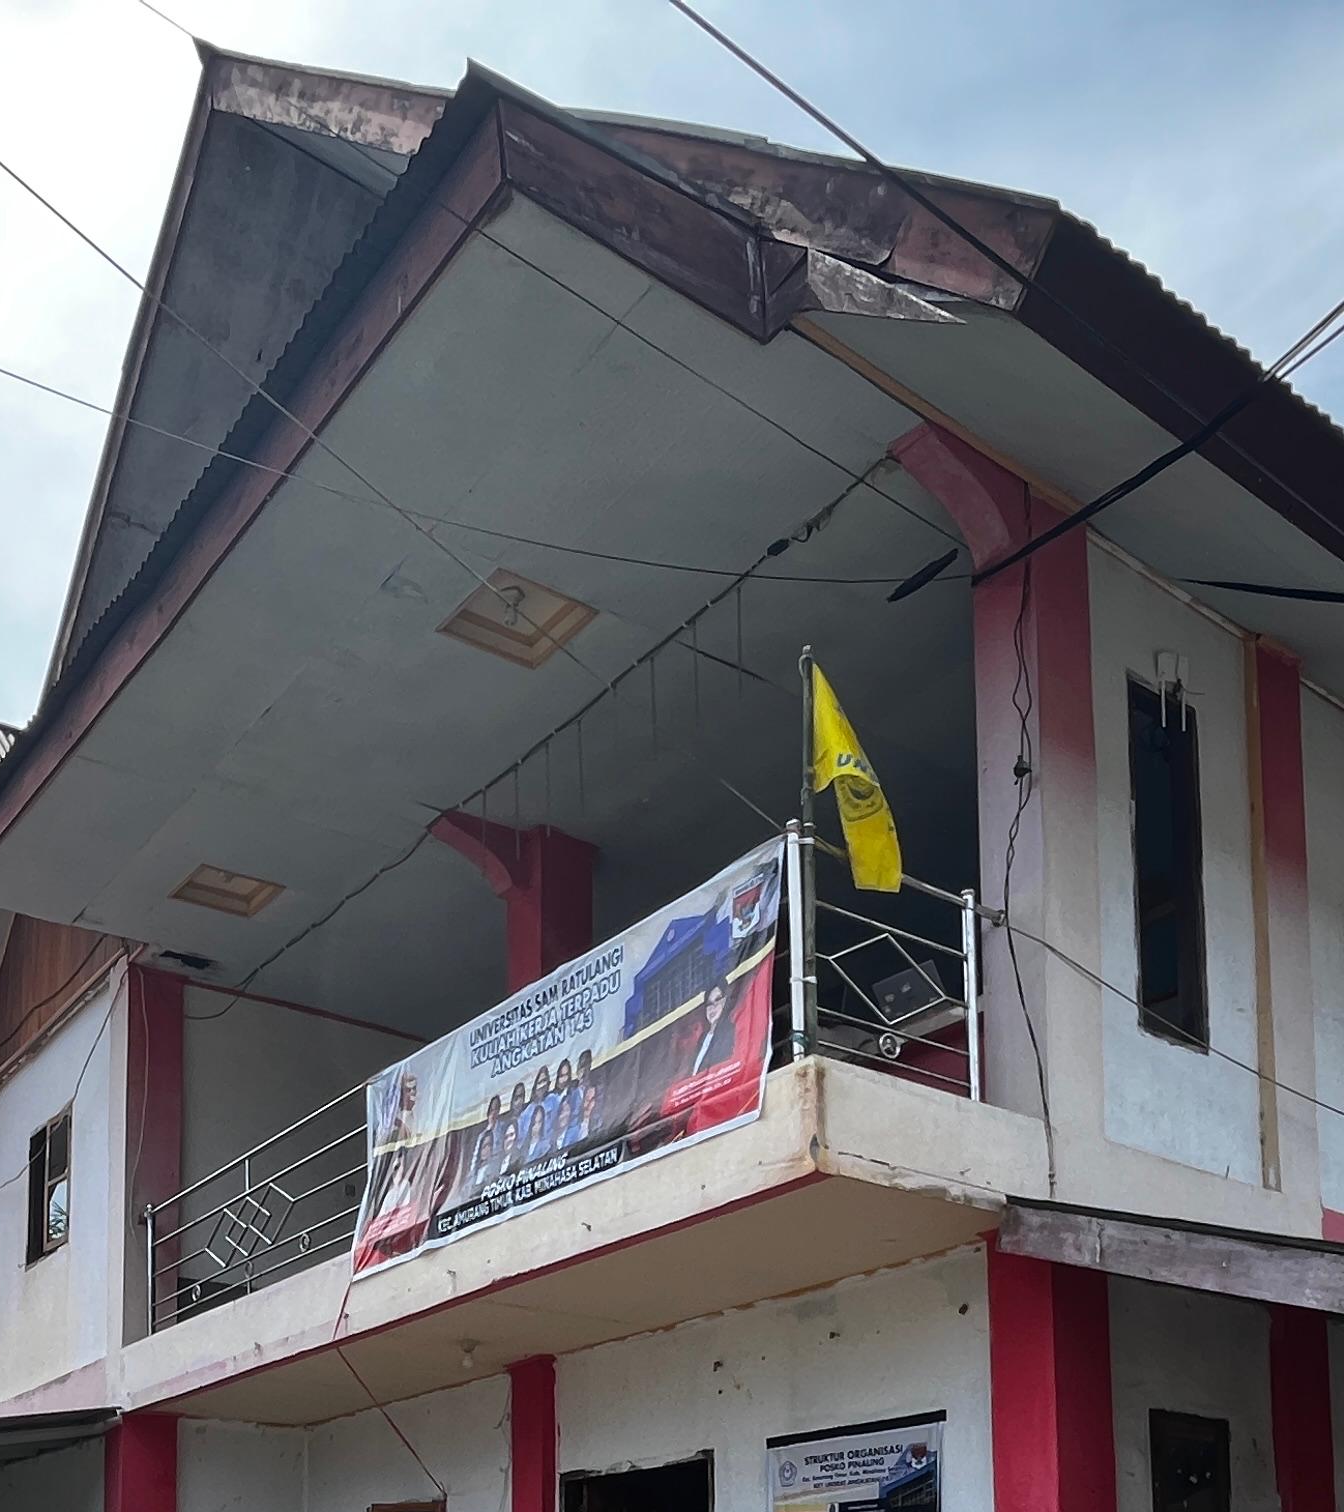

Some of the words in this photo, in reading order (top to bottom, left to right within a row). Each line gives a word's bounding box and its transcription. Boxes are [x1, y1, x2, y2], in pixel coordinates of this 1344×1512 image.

[469, 998, 533, 1047] UNIVERSITAS
[535, 984, 558, 1012] SAM
[561, 945, 624, 997] RATULANGI
[470, 1028, 518, 1070] KULIAH
[517, 1006, 558, 1045] KERJA
[560, 969, 621, 1022] TERPADU
[491, 1023, 566, 1079] ANGKATAN
[568, 1006, 594, 1038] 143
[481, 1175, 514, 1201] POSKO
[515, 1152, 569, 1188] PINALING
[578, 1147, 619, 1176] SELATAN
[804, 1451, 845, 1466] STRUKTUR
[847, 1443, 904, 1460] ORGANISASI
[820, 1462, 846, 1473] POSKO
[848, 1457, 885, 1469] PINALING
